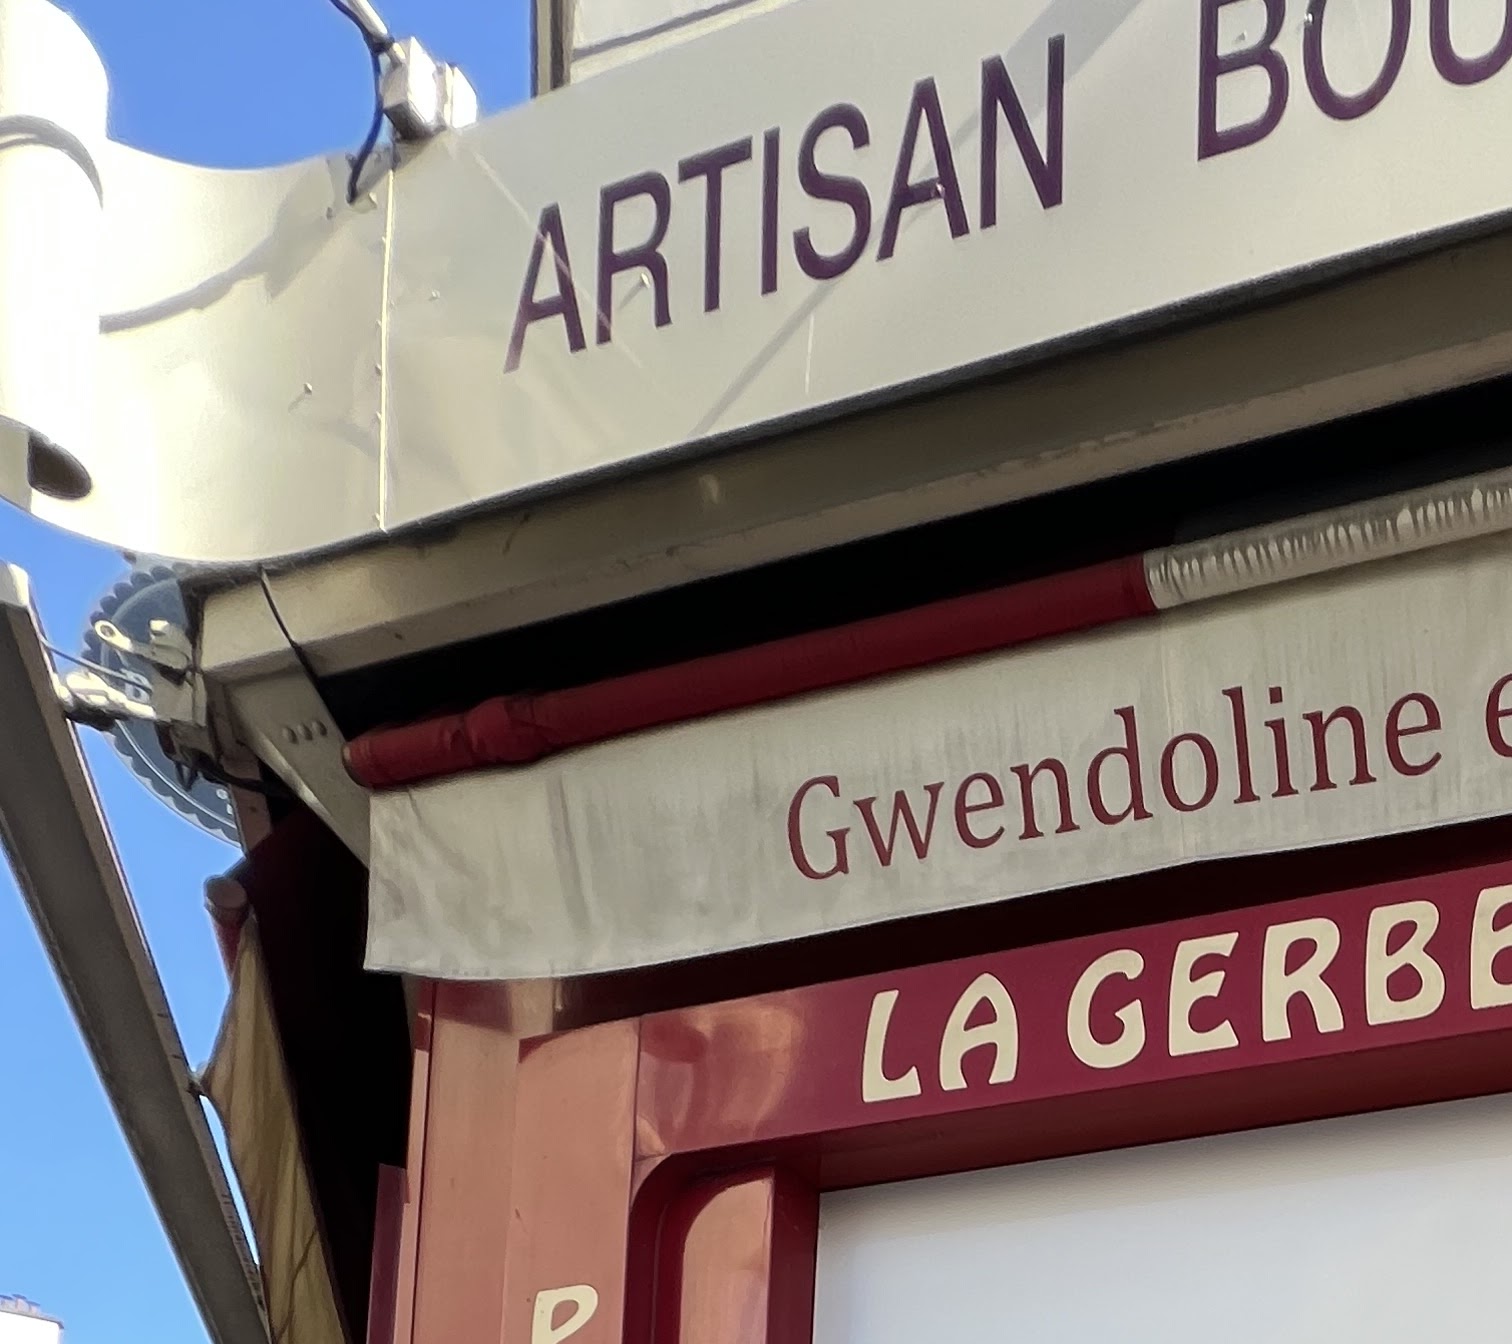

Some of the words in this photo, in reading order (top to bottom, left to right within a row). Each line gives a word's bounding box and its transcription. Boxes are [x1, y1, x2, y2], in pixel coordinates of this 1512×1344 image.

[503, 34, 1066, 373] ARTISAN
[788, 688, 1443, 881] Gwendoline
[862, 973, 1019, 1104] LA
